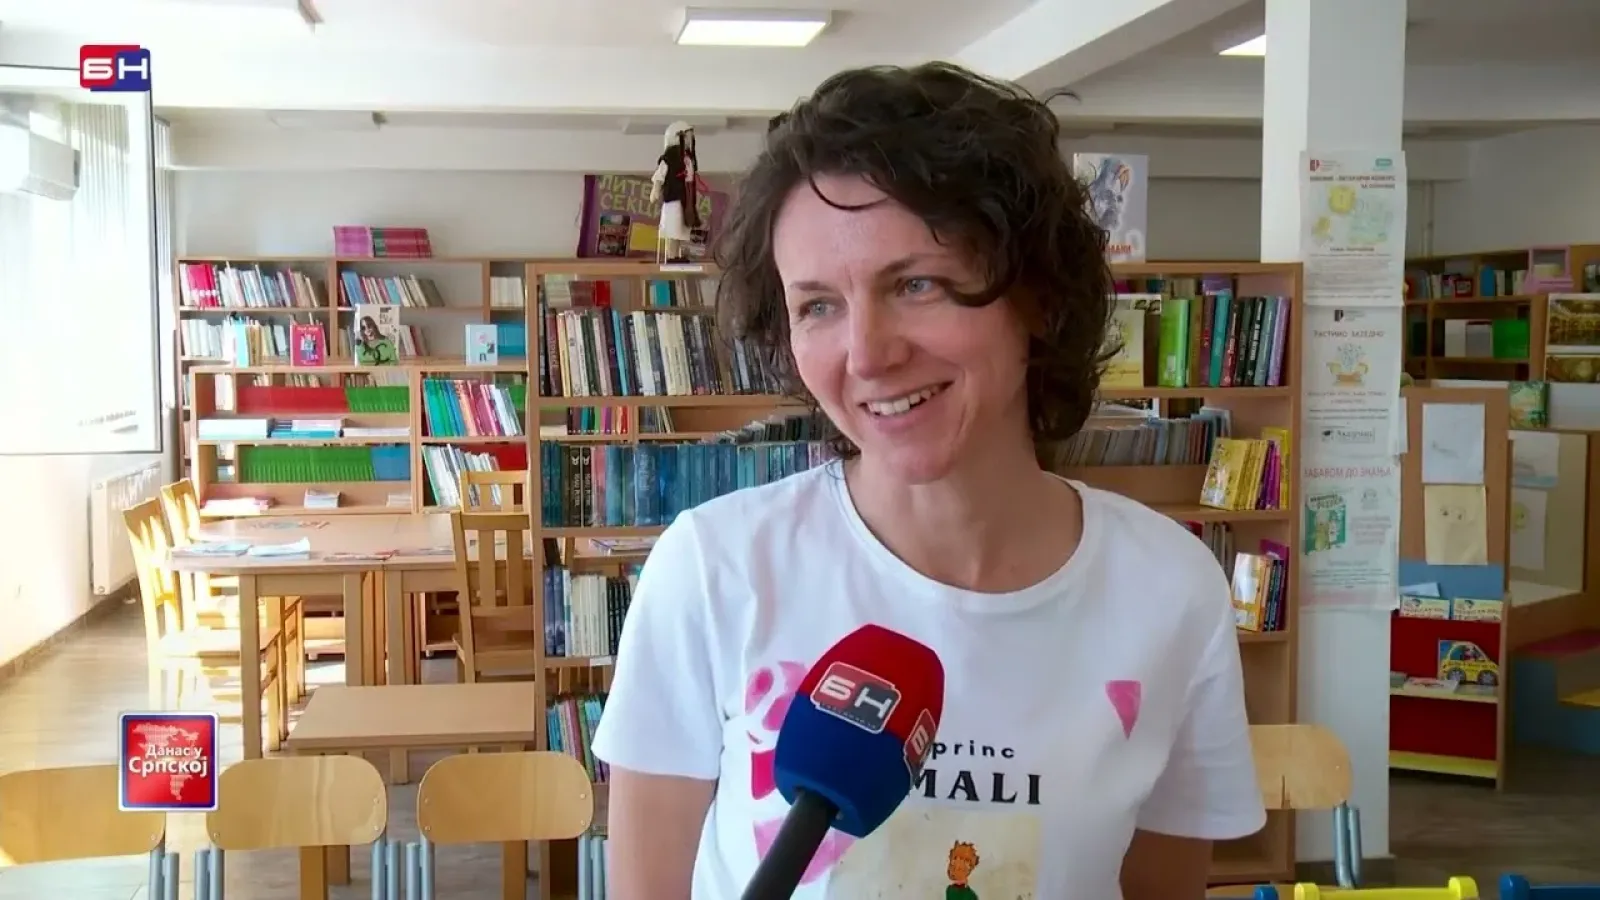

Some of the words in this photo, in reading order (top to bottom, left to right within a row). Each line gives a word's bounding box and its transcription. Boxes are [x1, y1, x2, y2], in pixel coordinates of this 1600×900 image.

[819, 674, 893, 719] БН
[931, 739, 1016, 760] princ
[913, 768, 1042, 805] MALI
